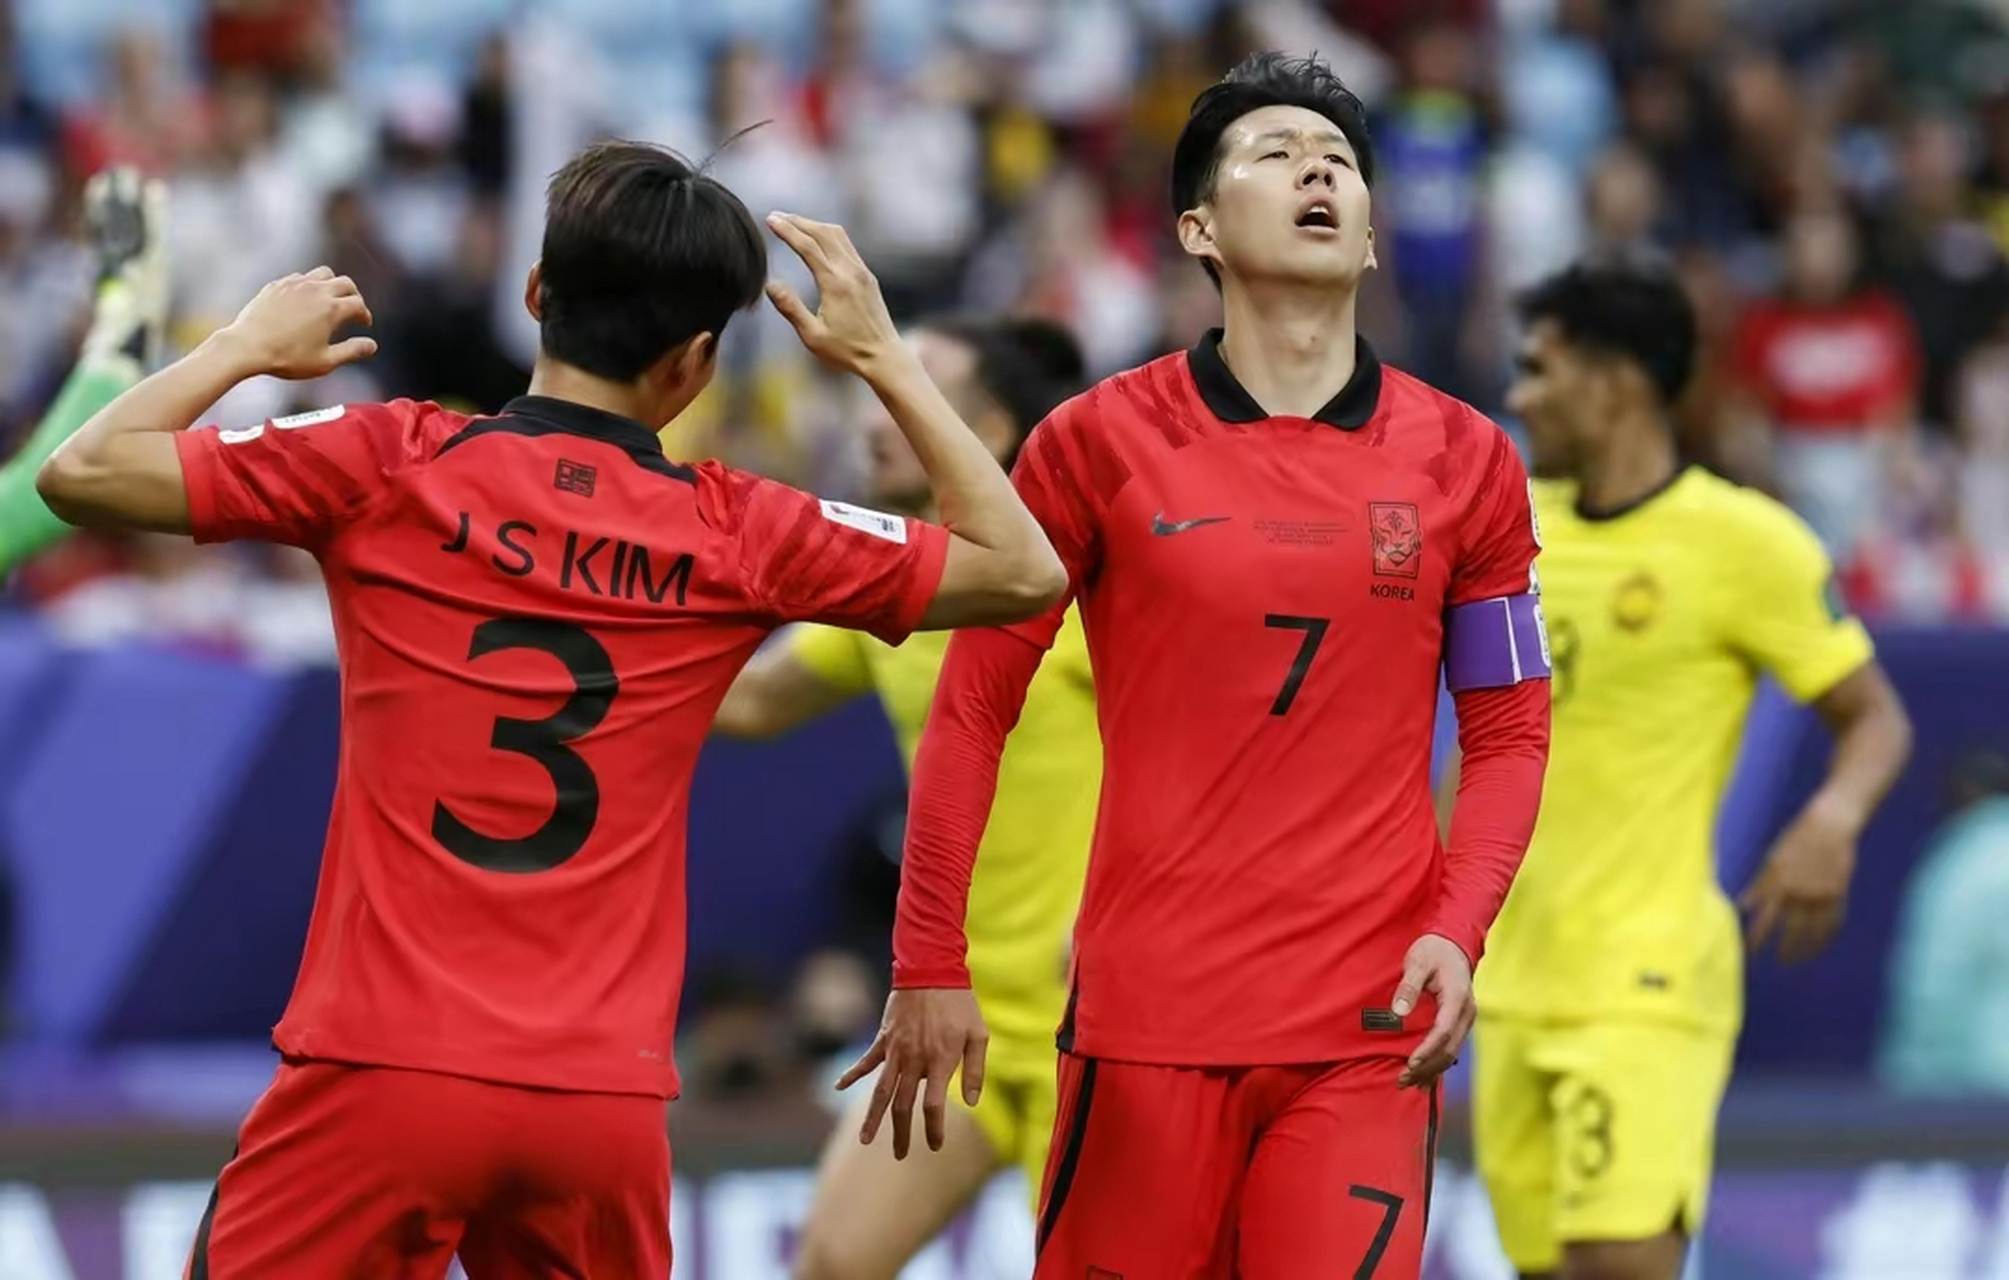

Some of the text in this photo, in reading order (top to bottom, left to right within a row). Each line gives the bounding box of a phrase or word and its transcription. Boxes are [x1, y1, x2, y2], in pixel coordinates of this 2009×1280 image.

[440, 511, 697, 607] J S KIM
[1370, 583, 1415, 601] KOREA
[1264, 613, 1331, 717] 7
[431, 617, 620, 874] 3
[1348, 1184, 1404, 1280] 7
